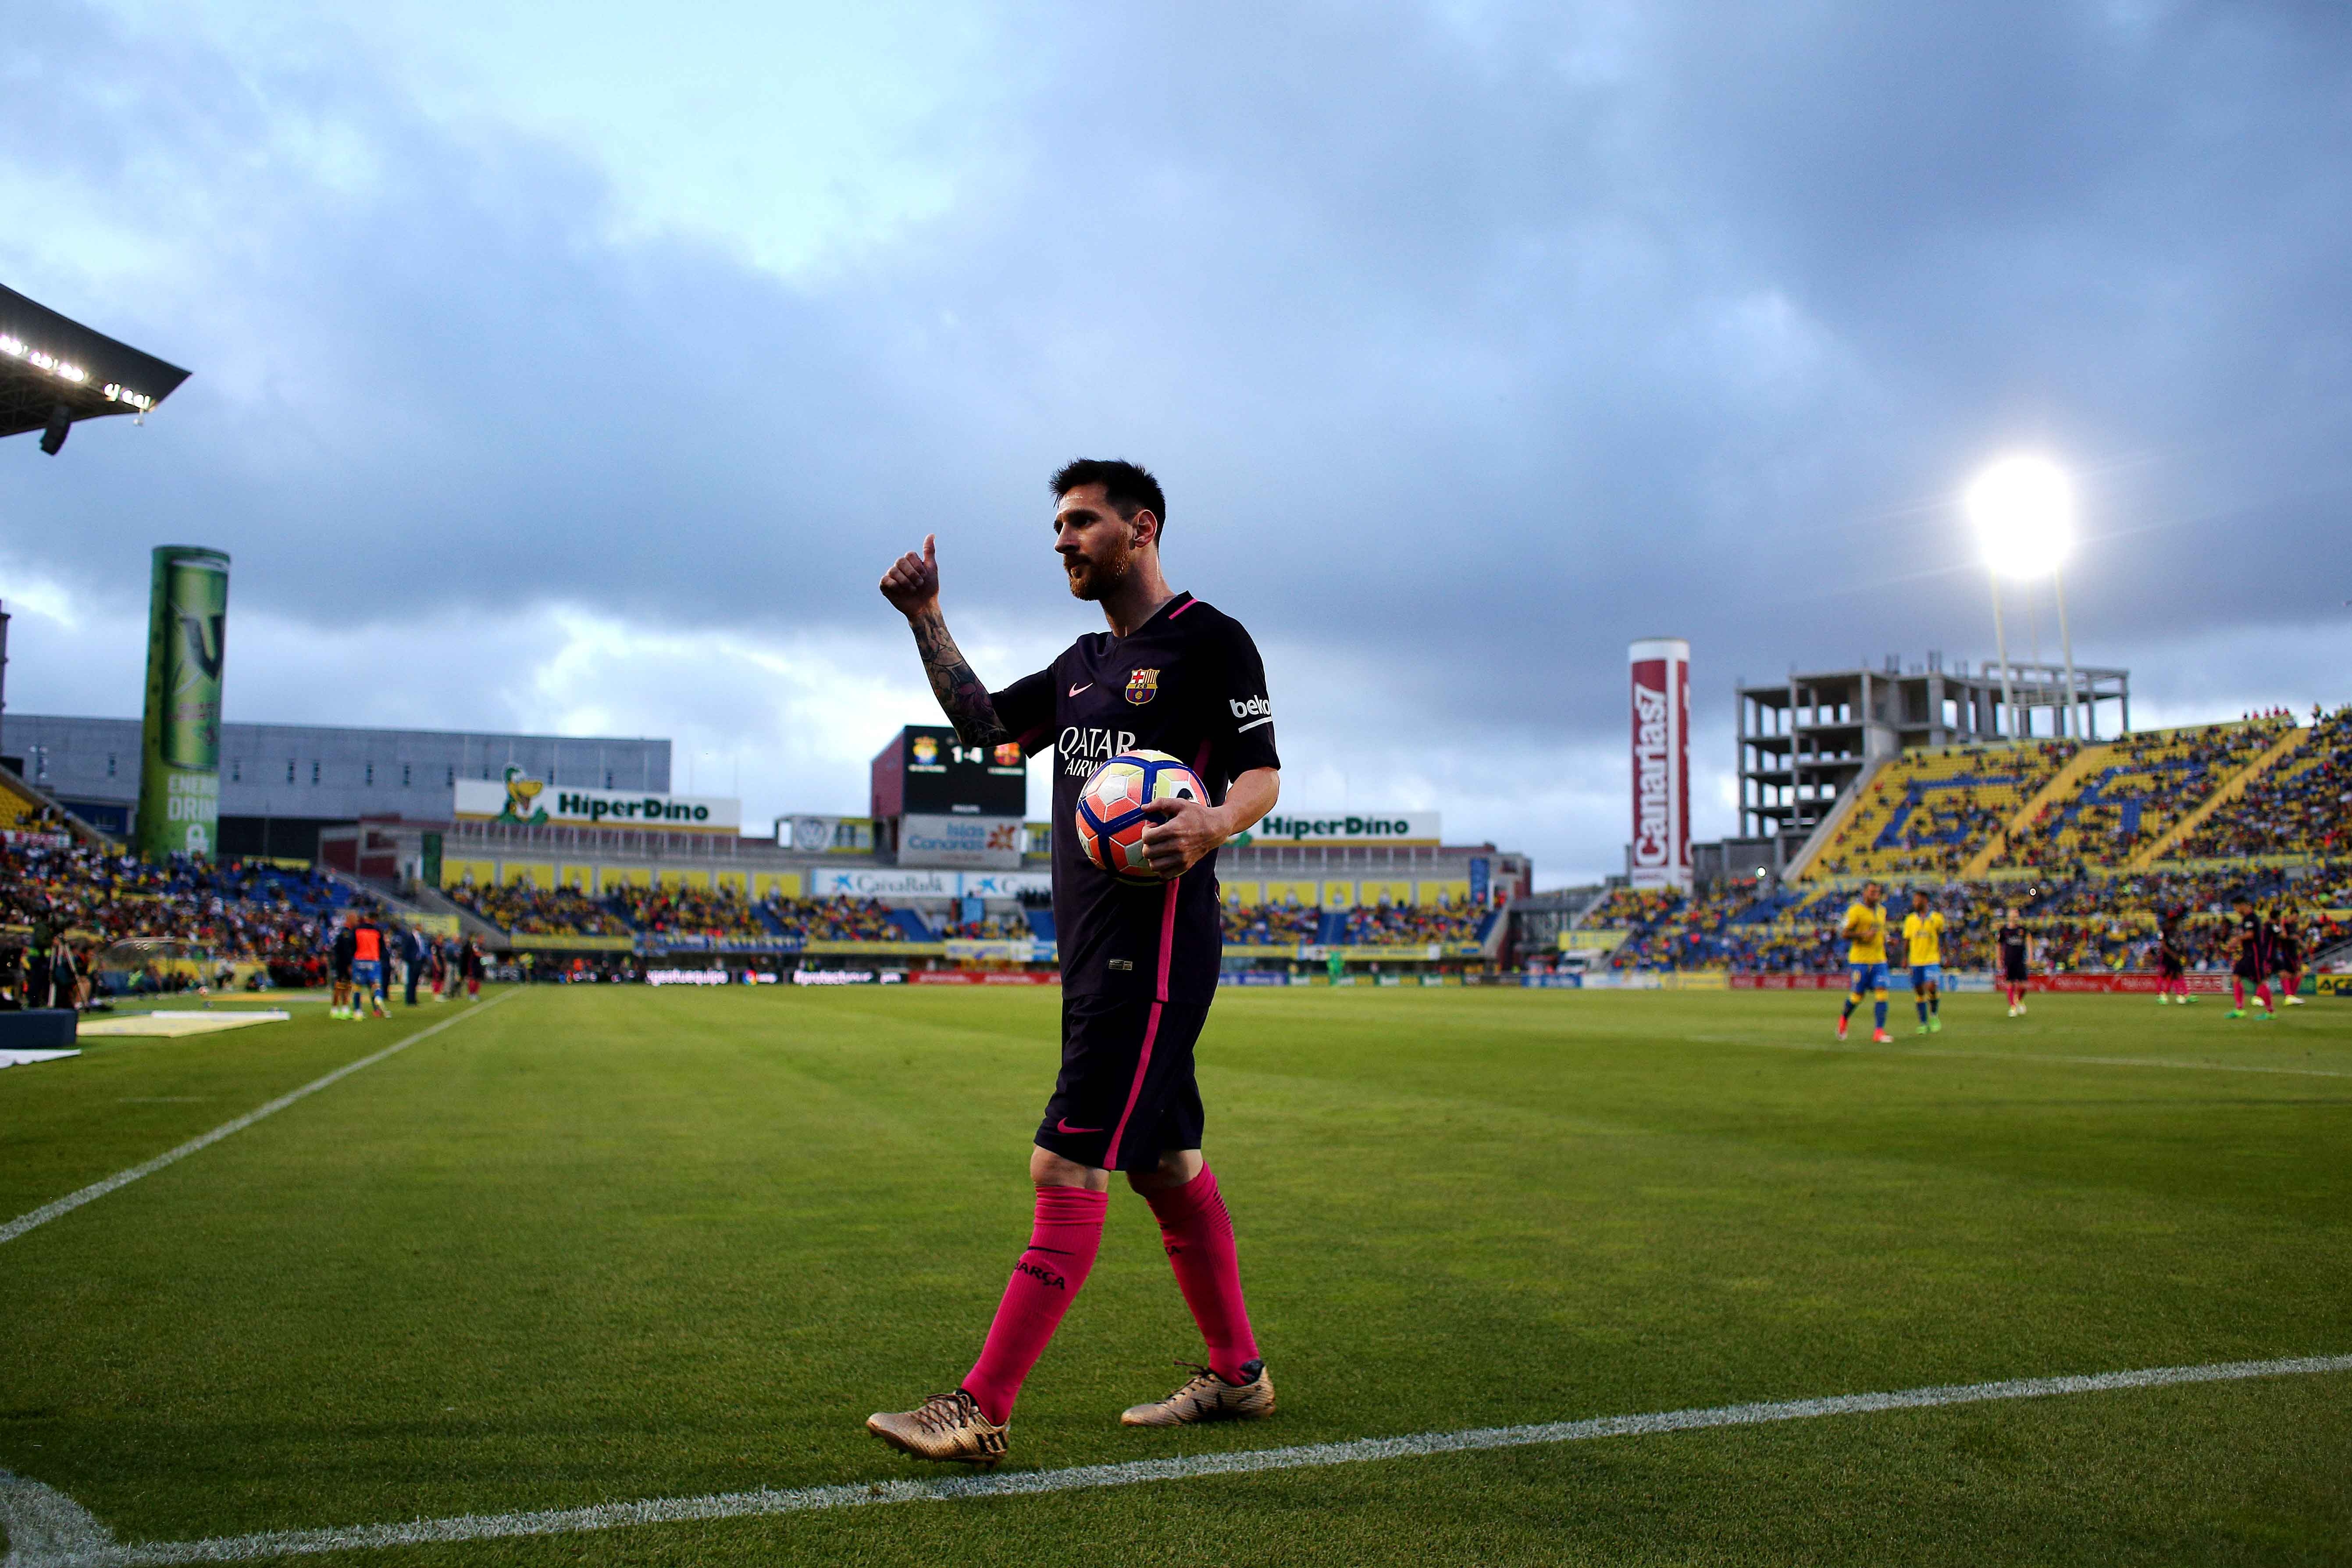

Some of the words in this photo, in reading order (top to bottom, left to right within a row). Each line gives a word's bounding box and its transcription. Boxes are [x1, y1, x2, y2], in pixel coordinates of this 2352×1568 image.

[1229, 695, 1271, 718] beko
[1058, 727, 1136, 761] QATAR
[1065, 758, 1103, 778] AIRW
[1634, 682, 1668, 866] Canarias7
[558, 792, 709, 822] HiperDino
[1262, 816, 1409, 841] HiperDino
[908, 835, 984, 850] Canarias
[857, 873, 944, 893] CaixaBank
